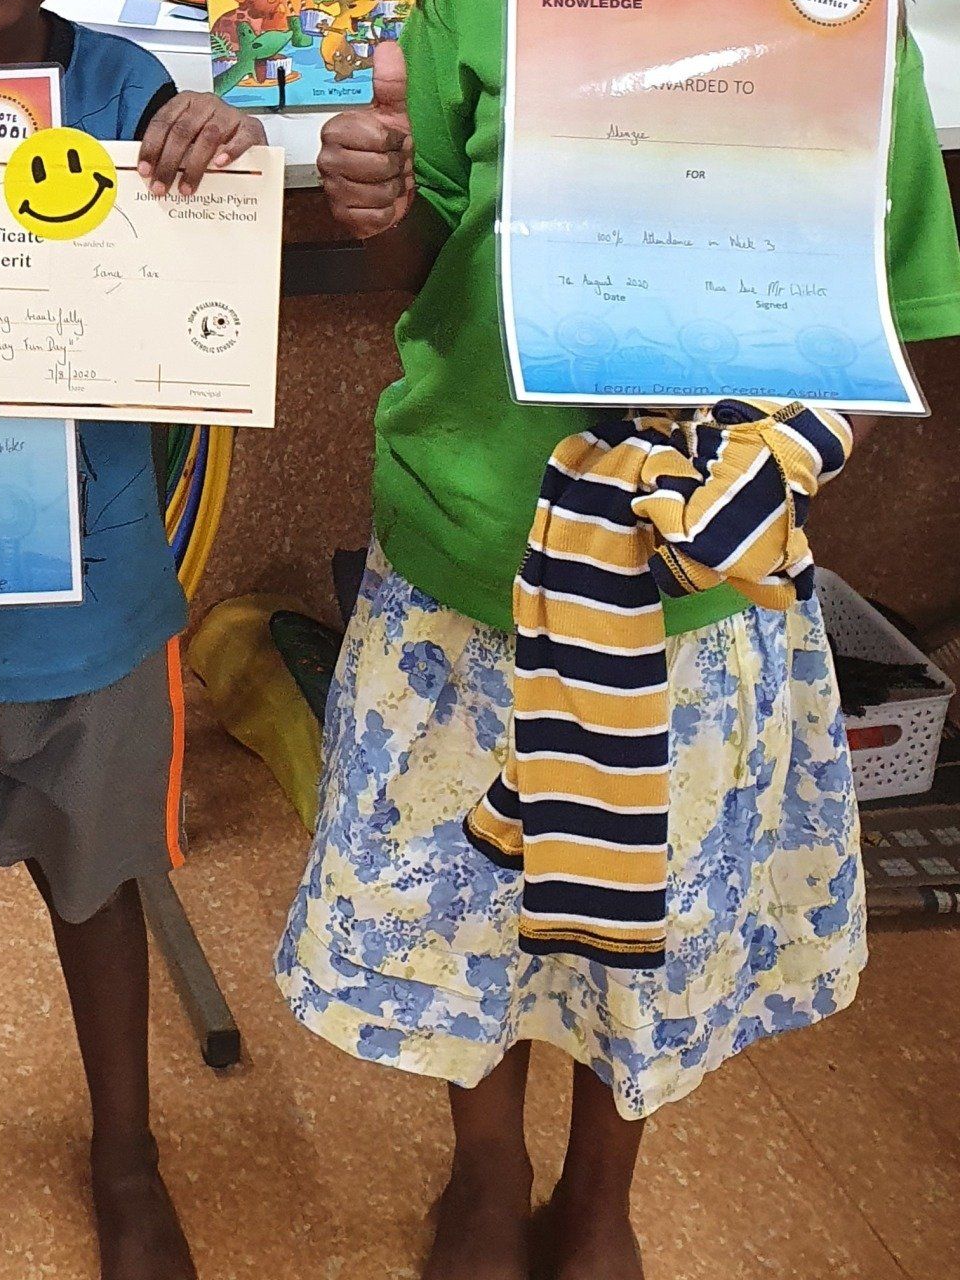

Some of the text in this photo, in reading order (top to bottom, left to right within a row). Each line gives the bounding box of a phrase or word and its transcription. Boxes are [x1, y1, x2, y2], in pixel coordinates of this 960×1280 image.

[733, 80, 755, 94] TO
[686, 170, 705, 179] FOR
[169, 209, 257, 221] Catholic School
[643, 230, 693, 246] Attendance
[627, 277, 648, 289] 2020
[603, 293, 626, 301] Date
[756, 301, 788, 310] Signed
